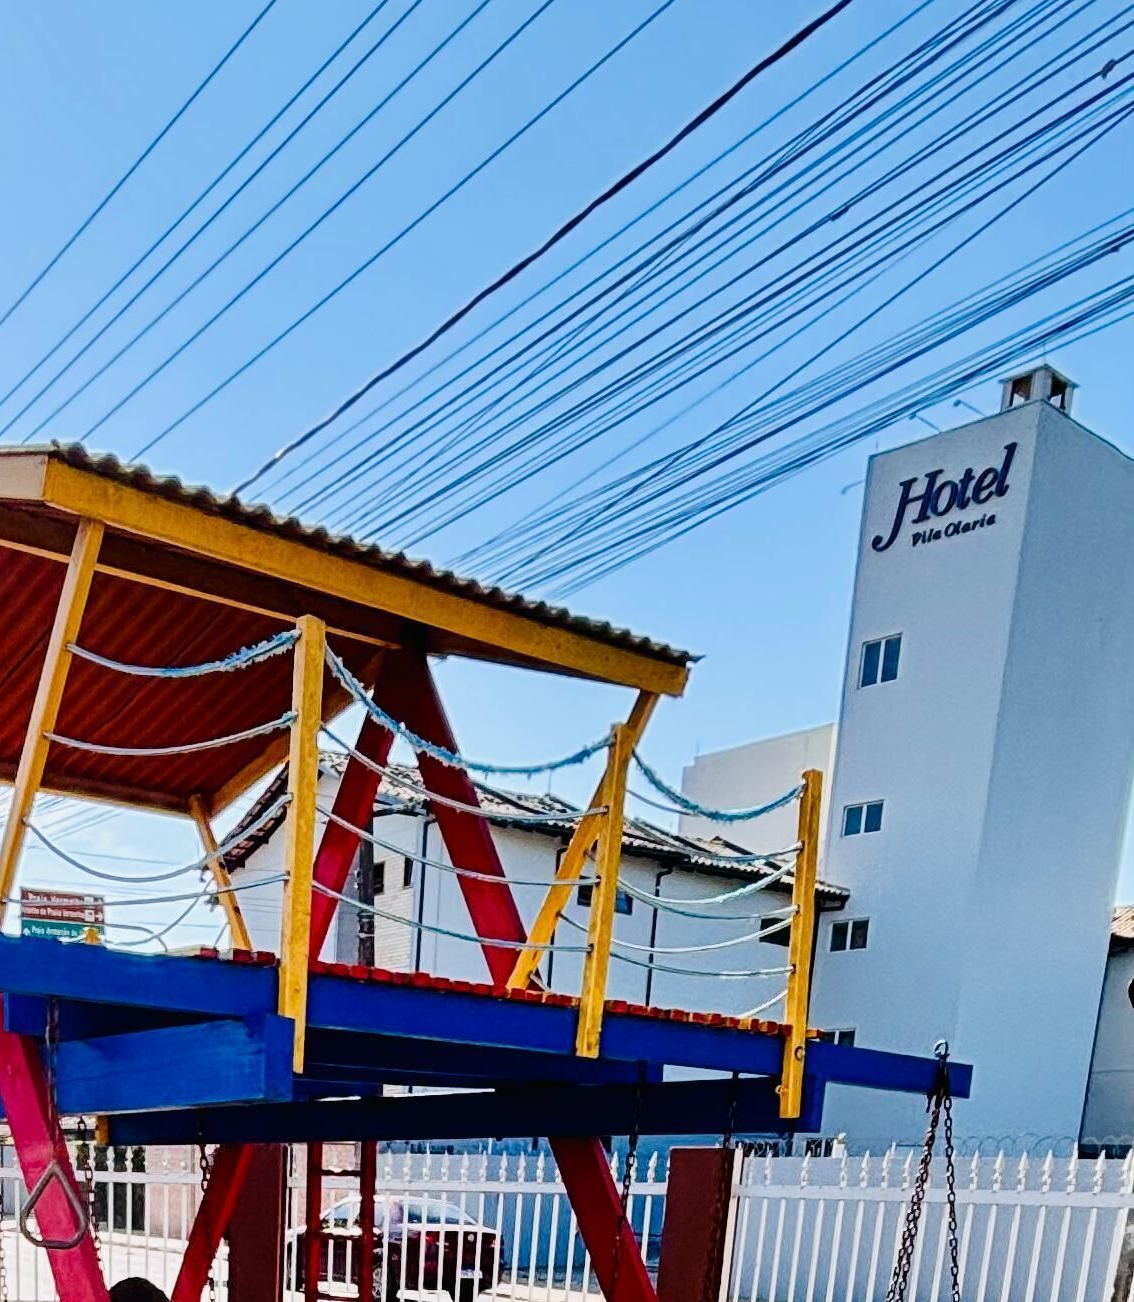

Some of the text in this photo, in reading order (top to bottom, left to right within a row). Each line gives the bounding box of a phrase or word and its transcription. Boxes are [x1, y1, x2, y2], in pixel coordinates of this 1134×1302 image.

[871, 442, 1018, 552] Hotel
[911, 513, 996, 547] Vila Olaria
